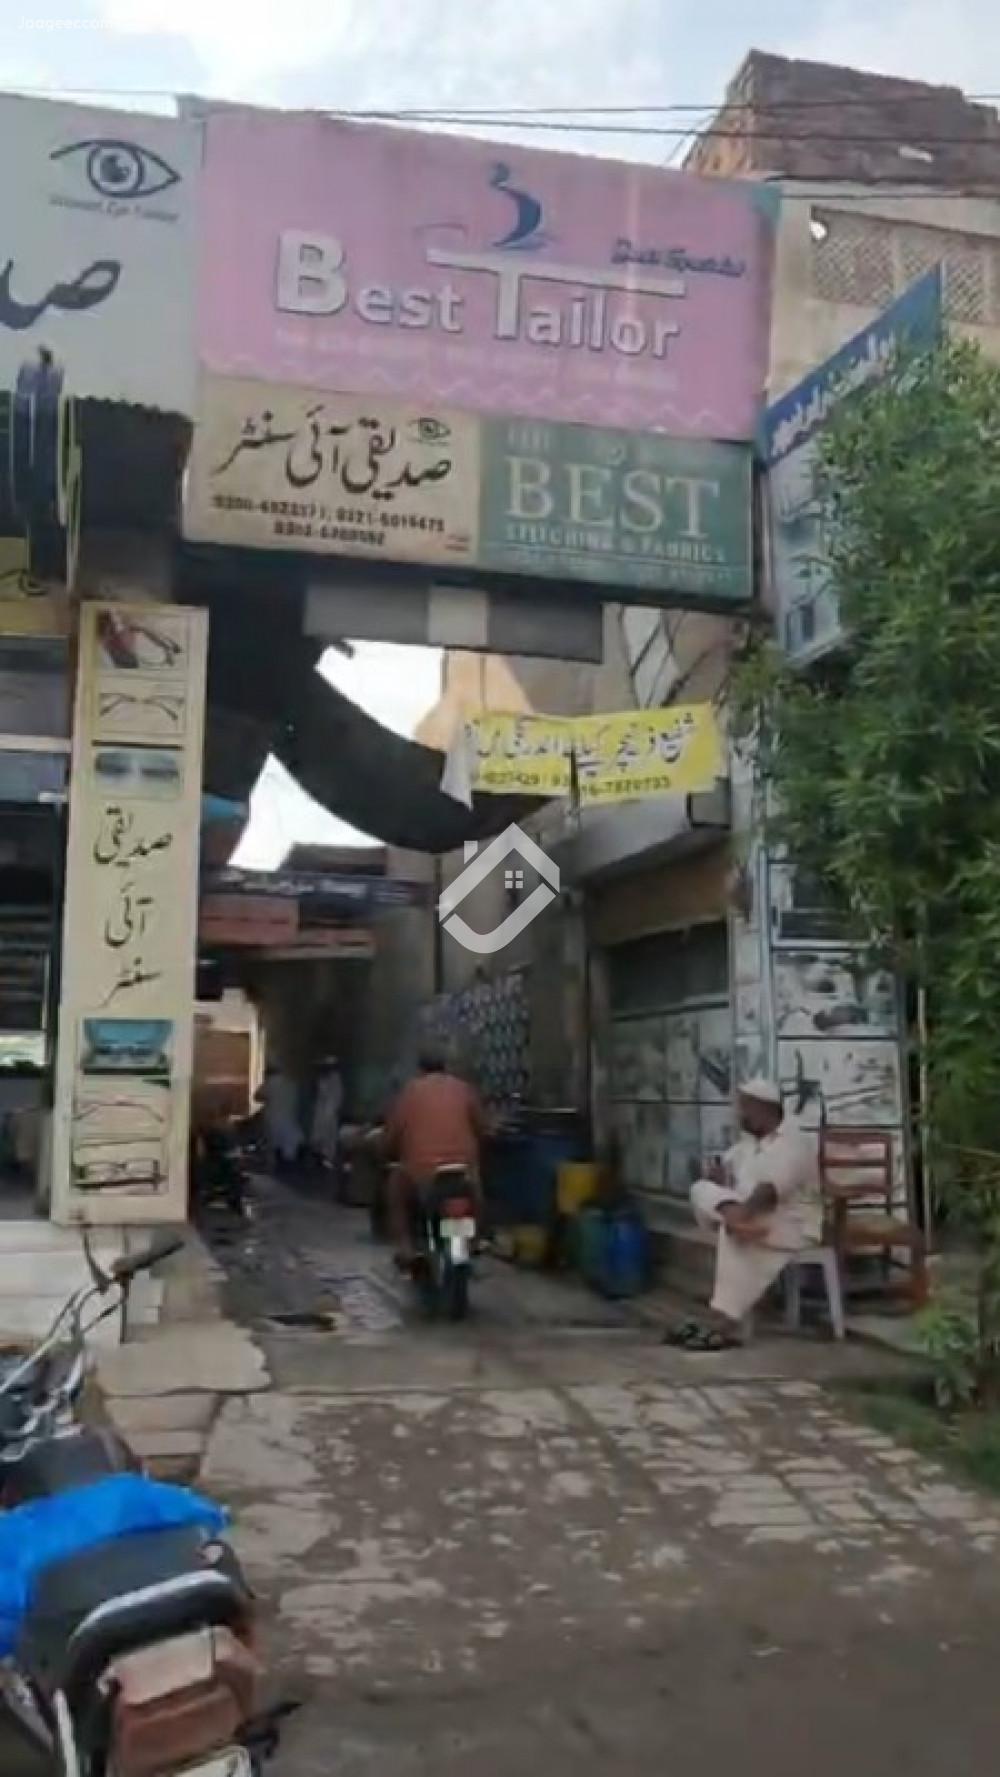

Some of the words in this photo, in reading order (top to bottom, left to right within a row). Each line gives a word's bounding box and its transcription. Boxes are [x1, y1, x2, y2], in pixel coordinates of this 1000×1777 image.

[275, 230, 463, 333] Best
[425, 247, 686, 358] Tailor
[504, 455, 720, 538] BEST
